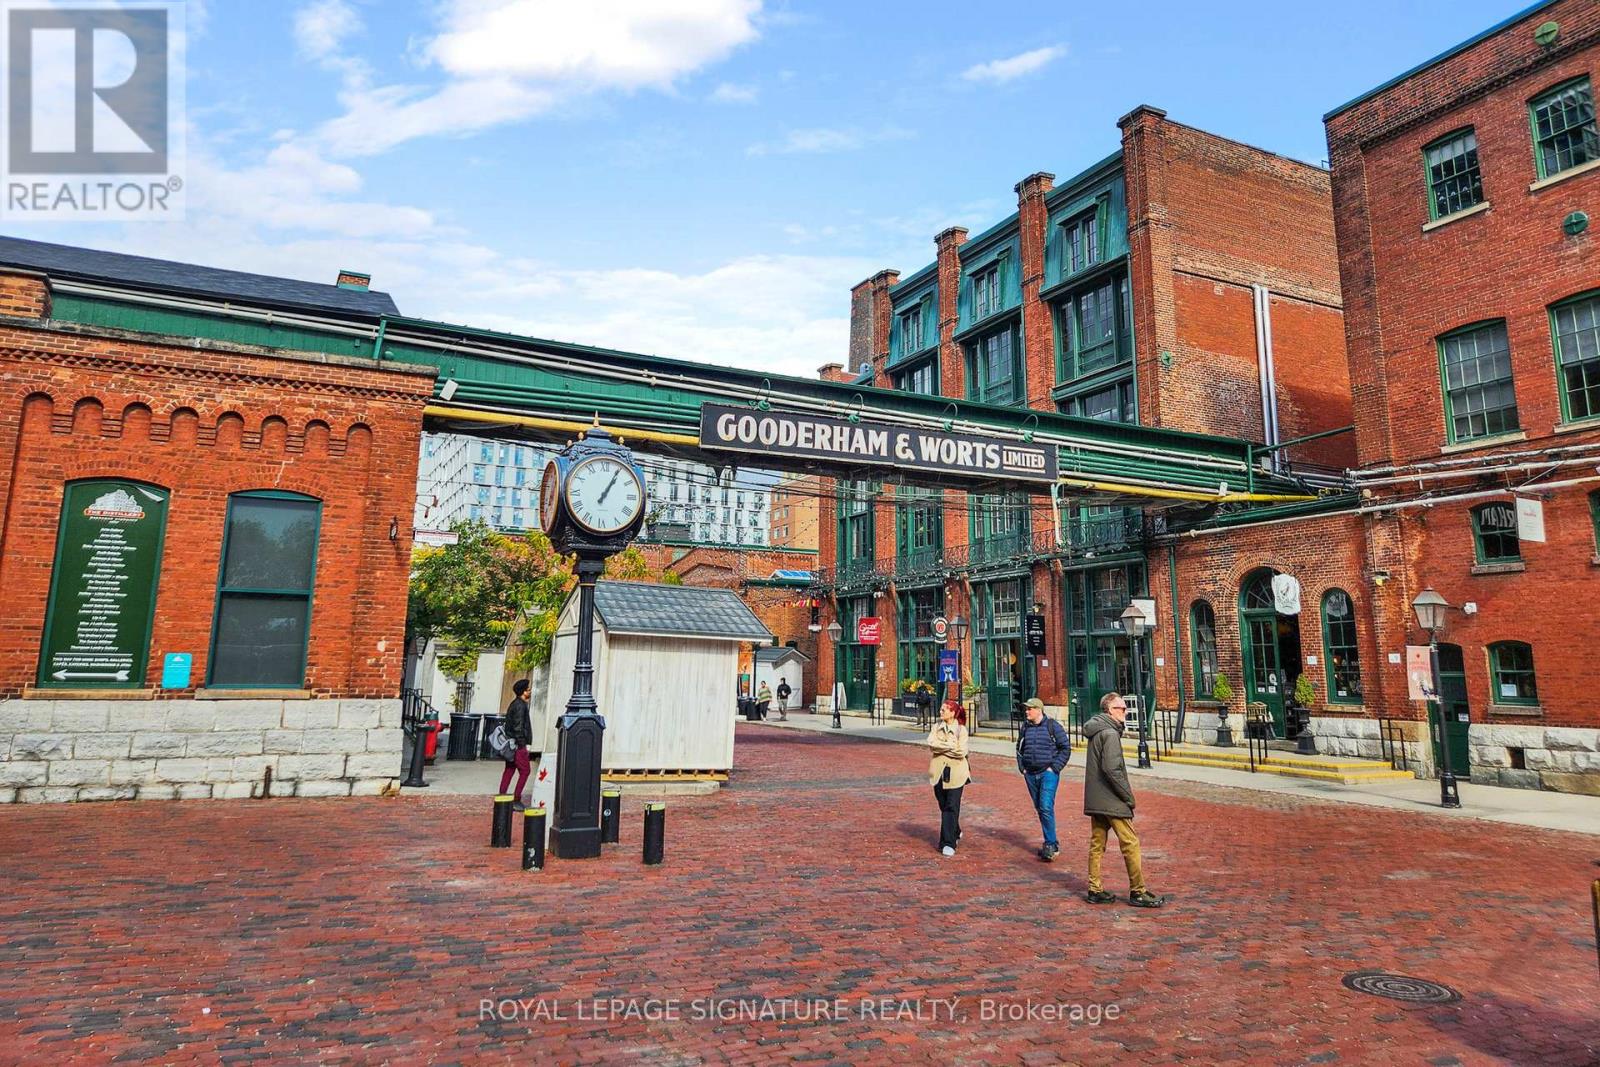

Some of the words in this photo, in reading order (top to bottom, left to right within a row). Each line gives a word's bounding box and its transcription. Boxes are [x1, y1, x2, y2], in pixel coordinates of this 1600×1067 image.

[716, 412, 888, 457] GOODERHAM
[895, 432, 915, 461] &
[918, 435, 1001, 469] WORTS
[1002, 450, 1046, 469] LIMITED
